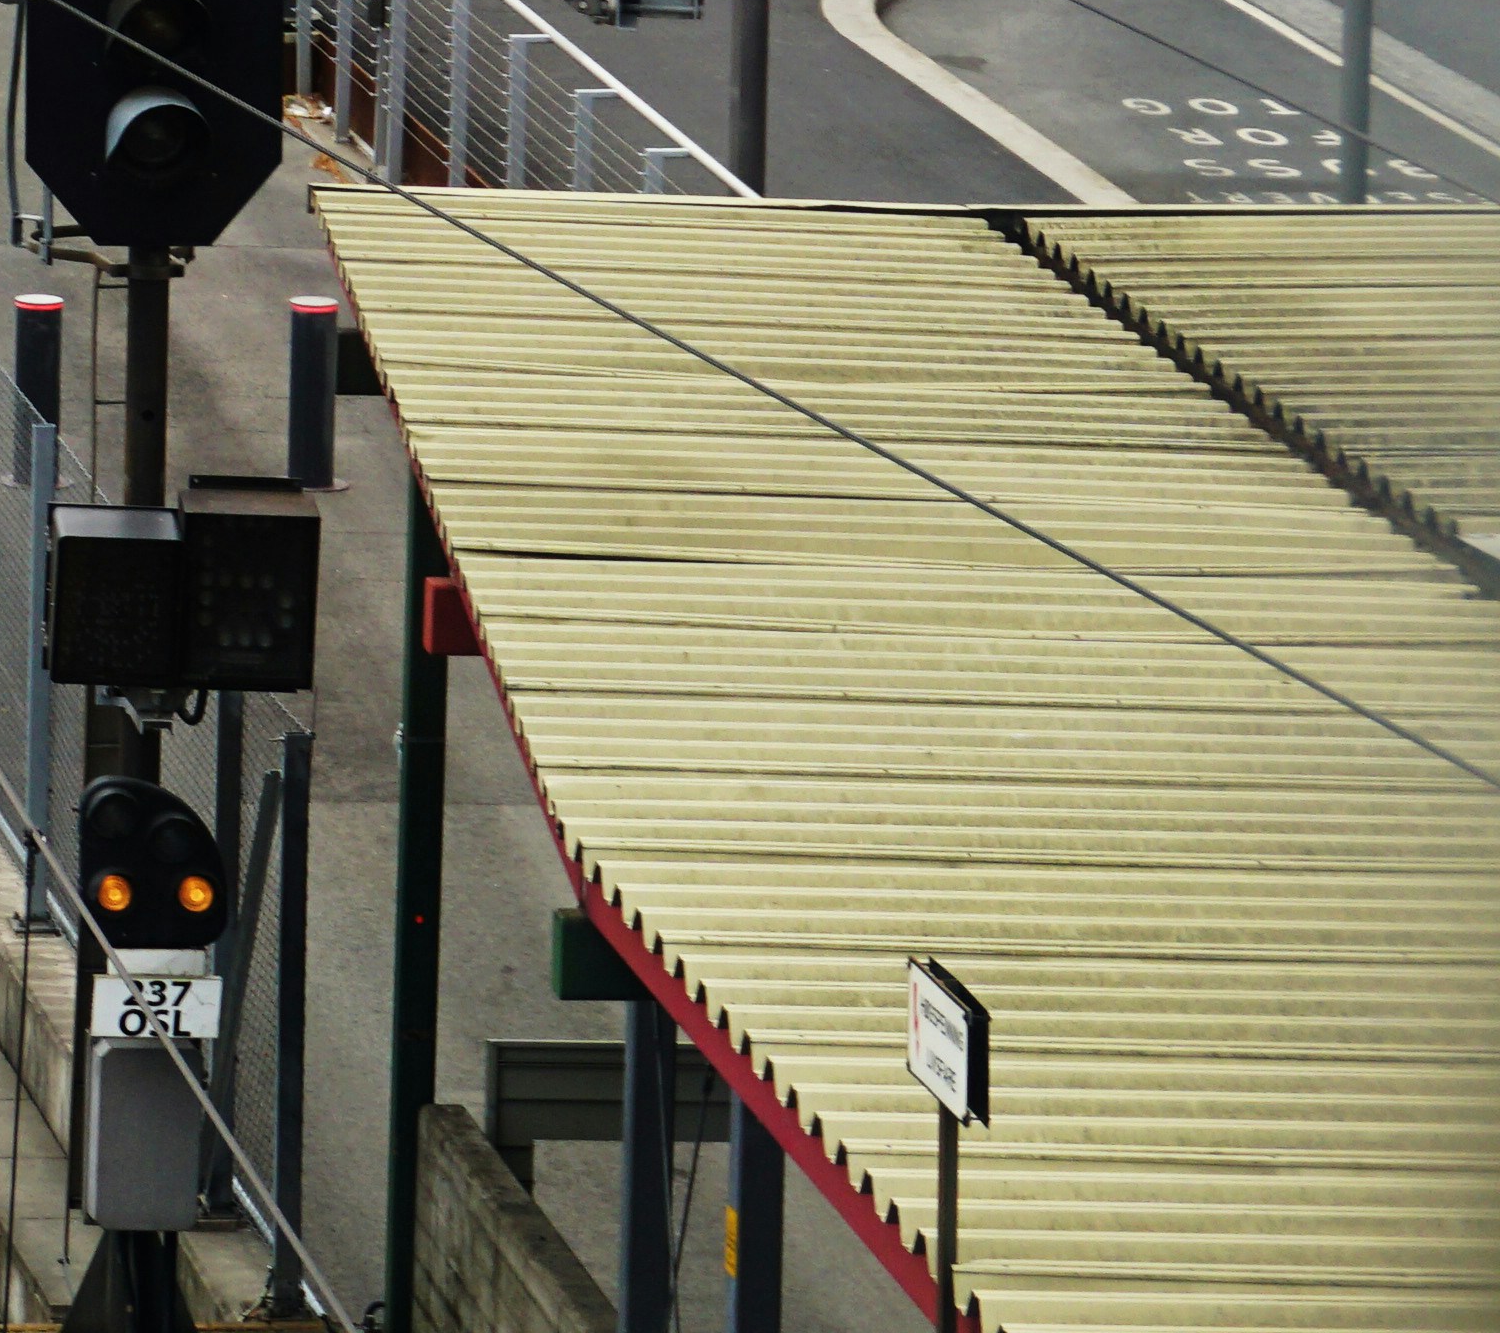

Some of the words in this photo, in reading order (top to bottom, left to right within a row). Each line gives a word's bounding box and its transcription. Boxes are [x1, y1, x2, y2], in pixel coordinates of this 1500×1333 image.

[1121, 97, 1303, 117] TOG
[122, 980, 192, 1008] 237
[119, 1010, 191, 1037] OSL
